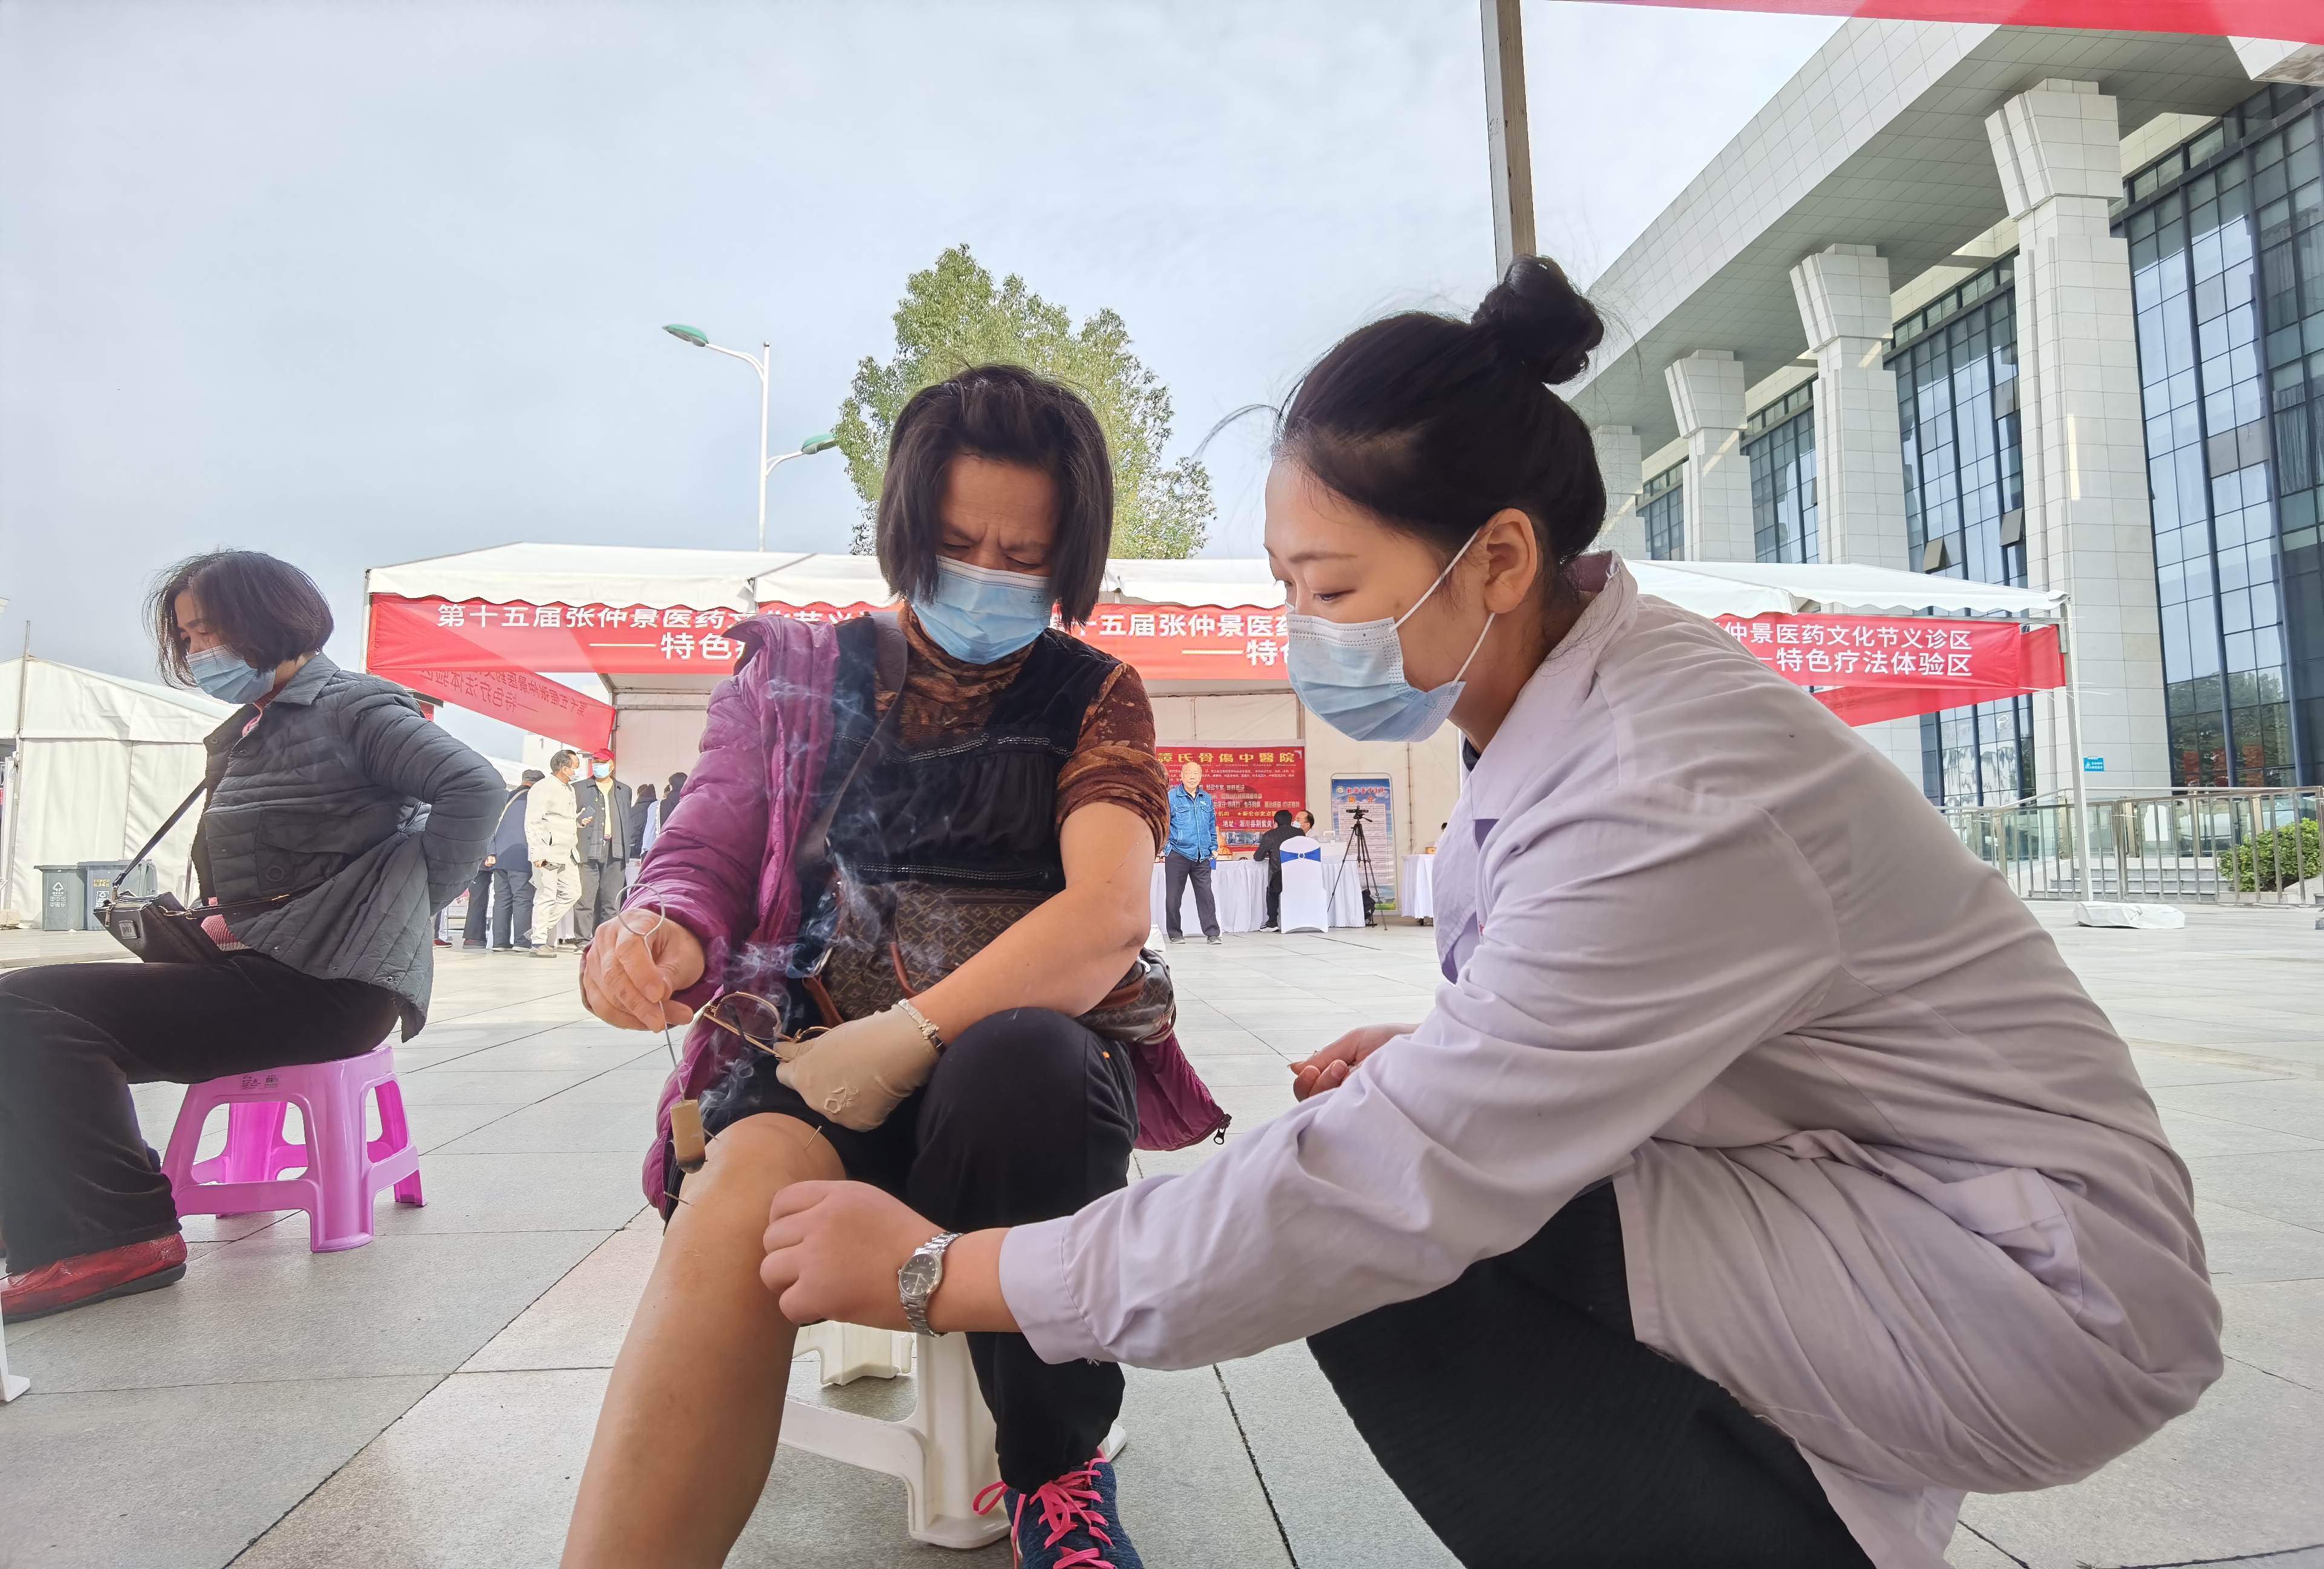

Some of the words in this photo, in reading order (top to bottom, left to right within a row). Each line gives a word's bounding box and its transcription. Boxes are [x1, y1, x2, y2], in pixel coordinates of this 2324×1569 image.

[1051, 613, 1288, 637] 五届张仲景医
[1715, 622, 1972, 650] 仲景医药文化节义诊区
